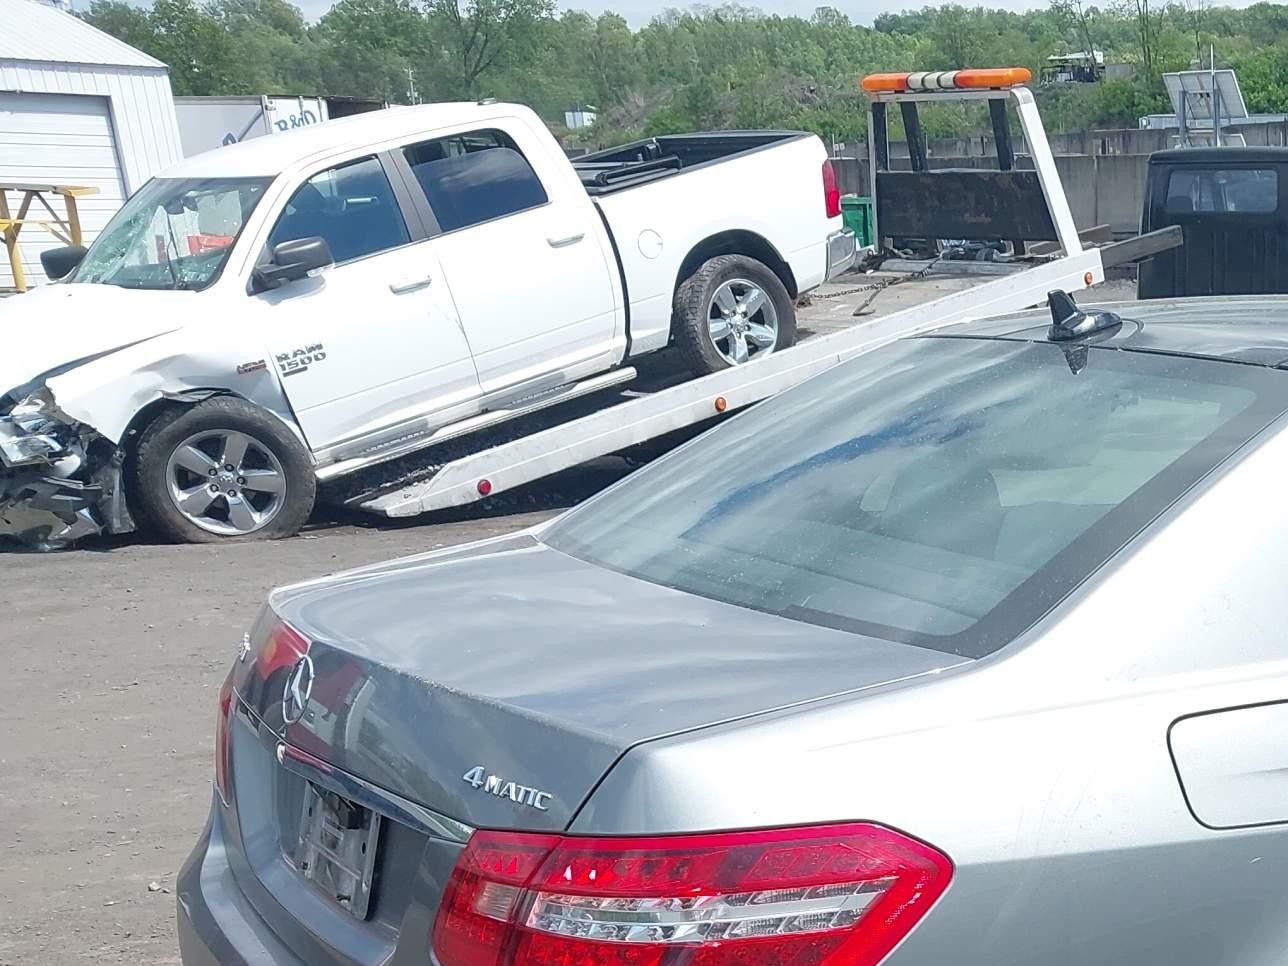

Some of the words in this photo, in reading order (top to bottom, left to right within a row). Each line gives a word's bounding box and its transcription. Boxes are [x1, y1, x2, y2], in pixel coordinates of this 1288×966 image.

[276, 344, 323, 362] RAM
[280, 352, 327, 372] 1500
[463, 766, 552, 811] 4MATIC
